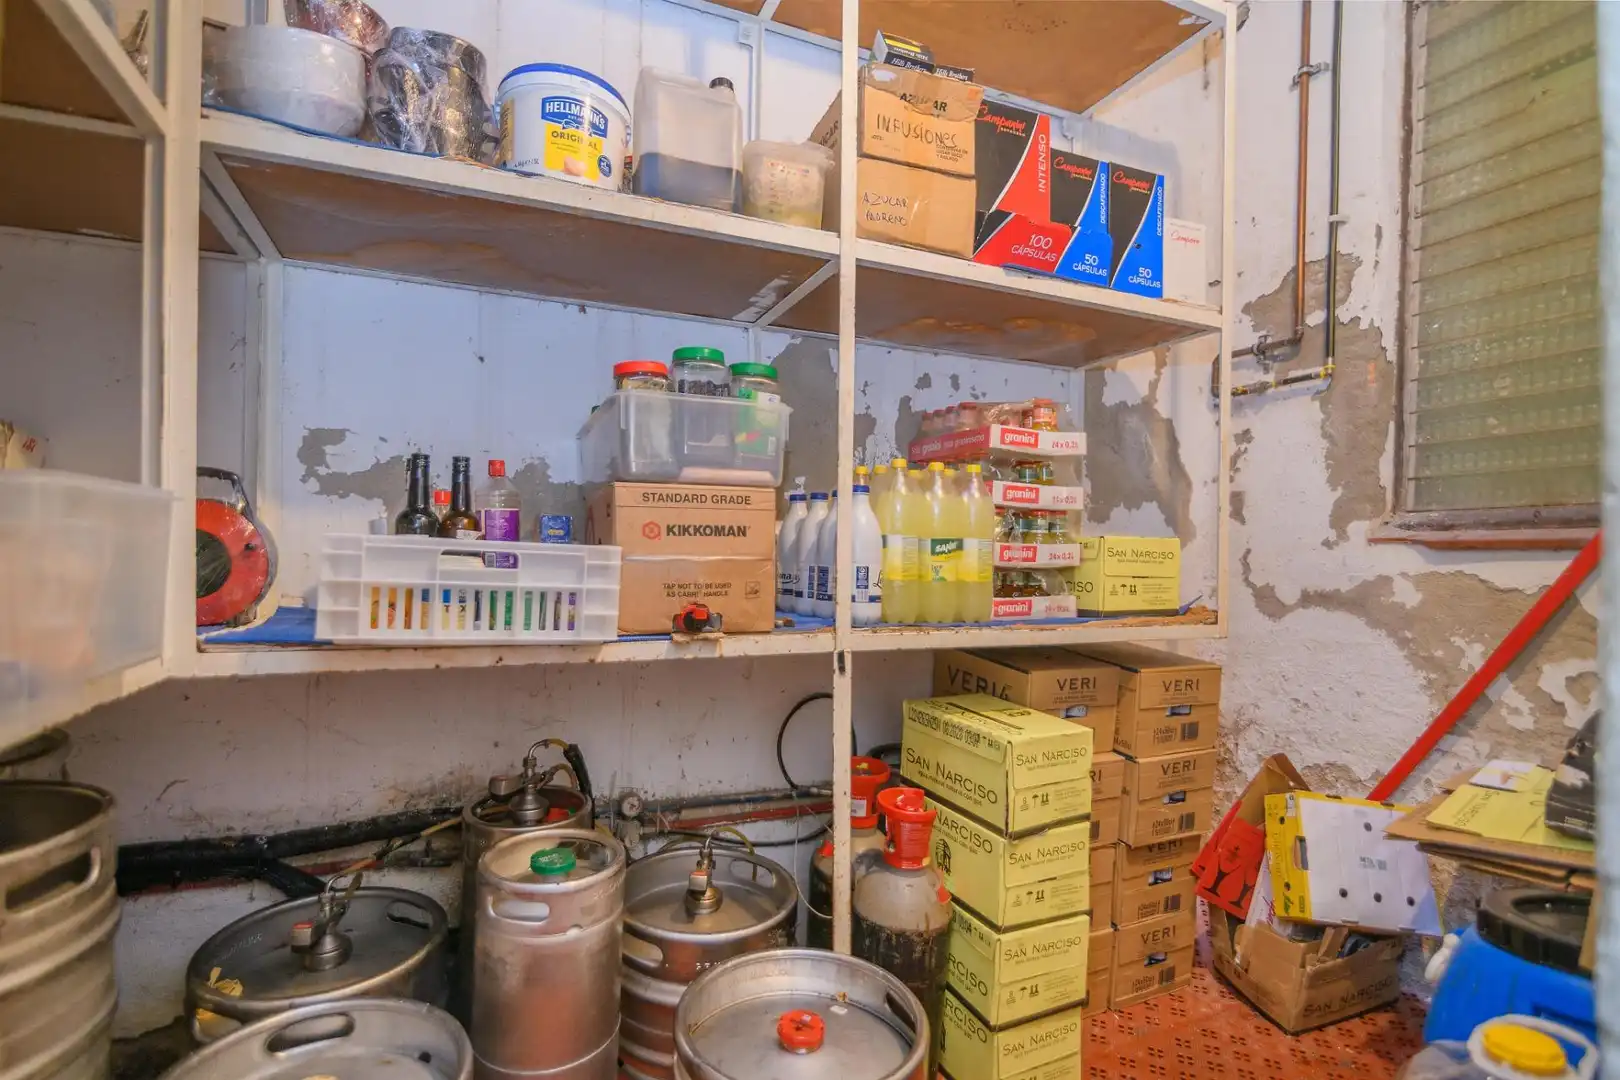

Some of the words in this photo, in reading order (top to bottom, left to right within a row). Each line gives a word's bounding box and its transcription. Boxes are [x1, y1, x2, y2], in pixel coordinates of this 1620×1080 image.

[551, 130, 597, 151] ORIGIAL
[1038, 134, 1046, 193] INTENSO
[862, 192, 909, 209] AZUCAR
[1029, 234, 1052, 249] 100
[1011, 244, 1056, 262] CÁPSULAS
[1084, 254, 1098, 266] 50
[1073, 262, 1107, 277] CÁPSULAS
[1138, 267, 1152, 279] 50
[1128, 275, 1161, 288] CÁPSULAS
[1004, 432, 1035, 445] granini
[642, 492, 708, 505] STANDARD
[711, 494, 751, 505] GRADE
[1006, 489, 1036, 500] granini
[666, 524, 747, 537] KIKKOMAN
[1107, 547, 1127, 558] SAN
[1131, 549, 1174, 560] NARCISO
[998, 602, 1028, 615] granini
[1056, 676, 1096, 691] VERI
[1162, 678, 1200, 692] VERI
[1016, 754, 1037, 766] SAN
[1041, 747, 1087, 761] NARCISO
[1160, 759, 1197, 775] VERI
[906, 747, 930, 771] SAN
[936, 760, 998, 804] NARCISO
[1008, 852, 1032, 865] SAN
[1037, 841, 1086, 858] NARCISO
[1141, 925, 1176, 944] VERI
[1004, 948, 1026, 962] SAN
[1032, 936, 1081, 954] NARCISO
[1002, 1041, 1025, 1056] SAN
[1029, 1022, 1078, 1047] NARCISO
